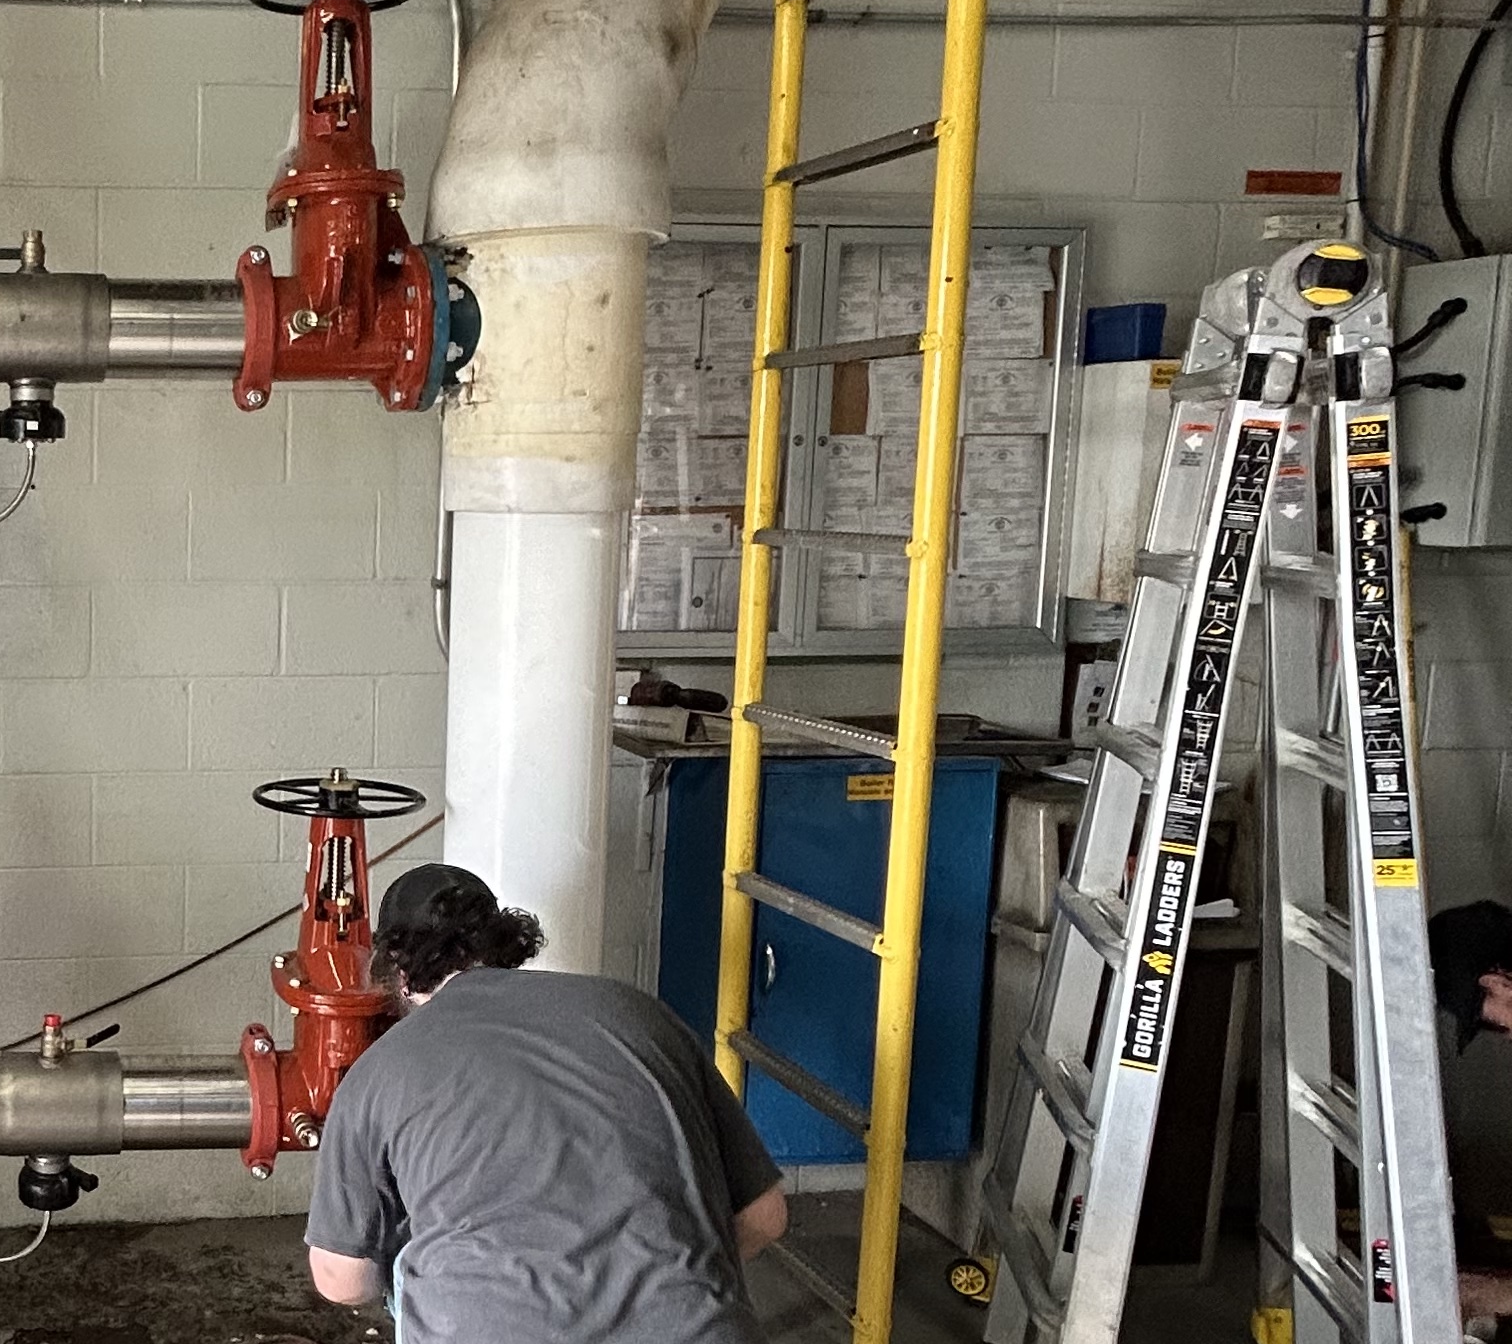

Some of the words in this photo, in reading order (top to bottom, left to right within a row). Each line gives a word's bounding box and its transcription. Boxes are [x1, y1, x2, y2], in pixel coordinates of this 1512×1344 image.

[1349, 423, 1381, 437] 300
[1376, 864, 1396, 876] 25
[1133, 978, 1165, 1059] GORILLA
[1152, 859, 1186, 947] LADDERS
